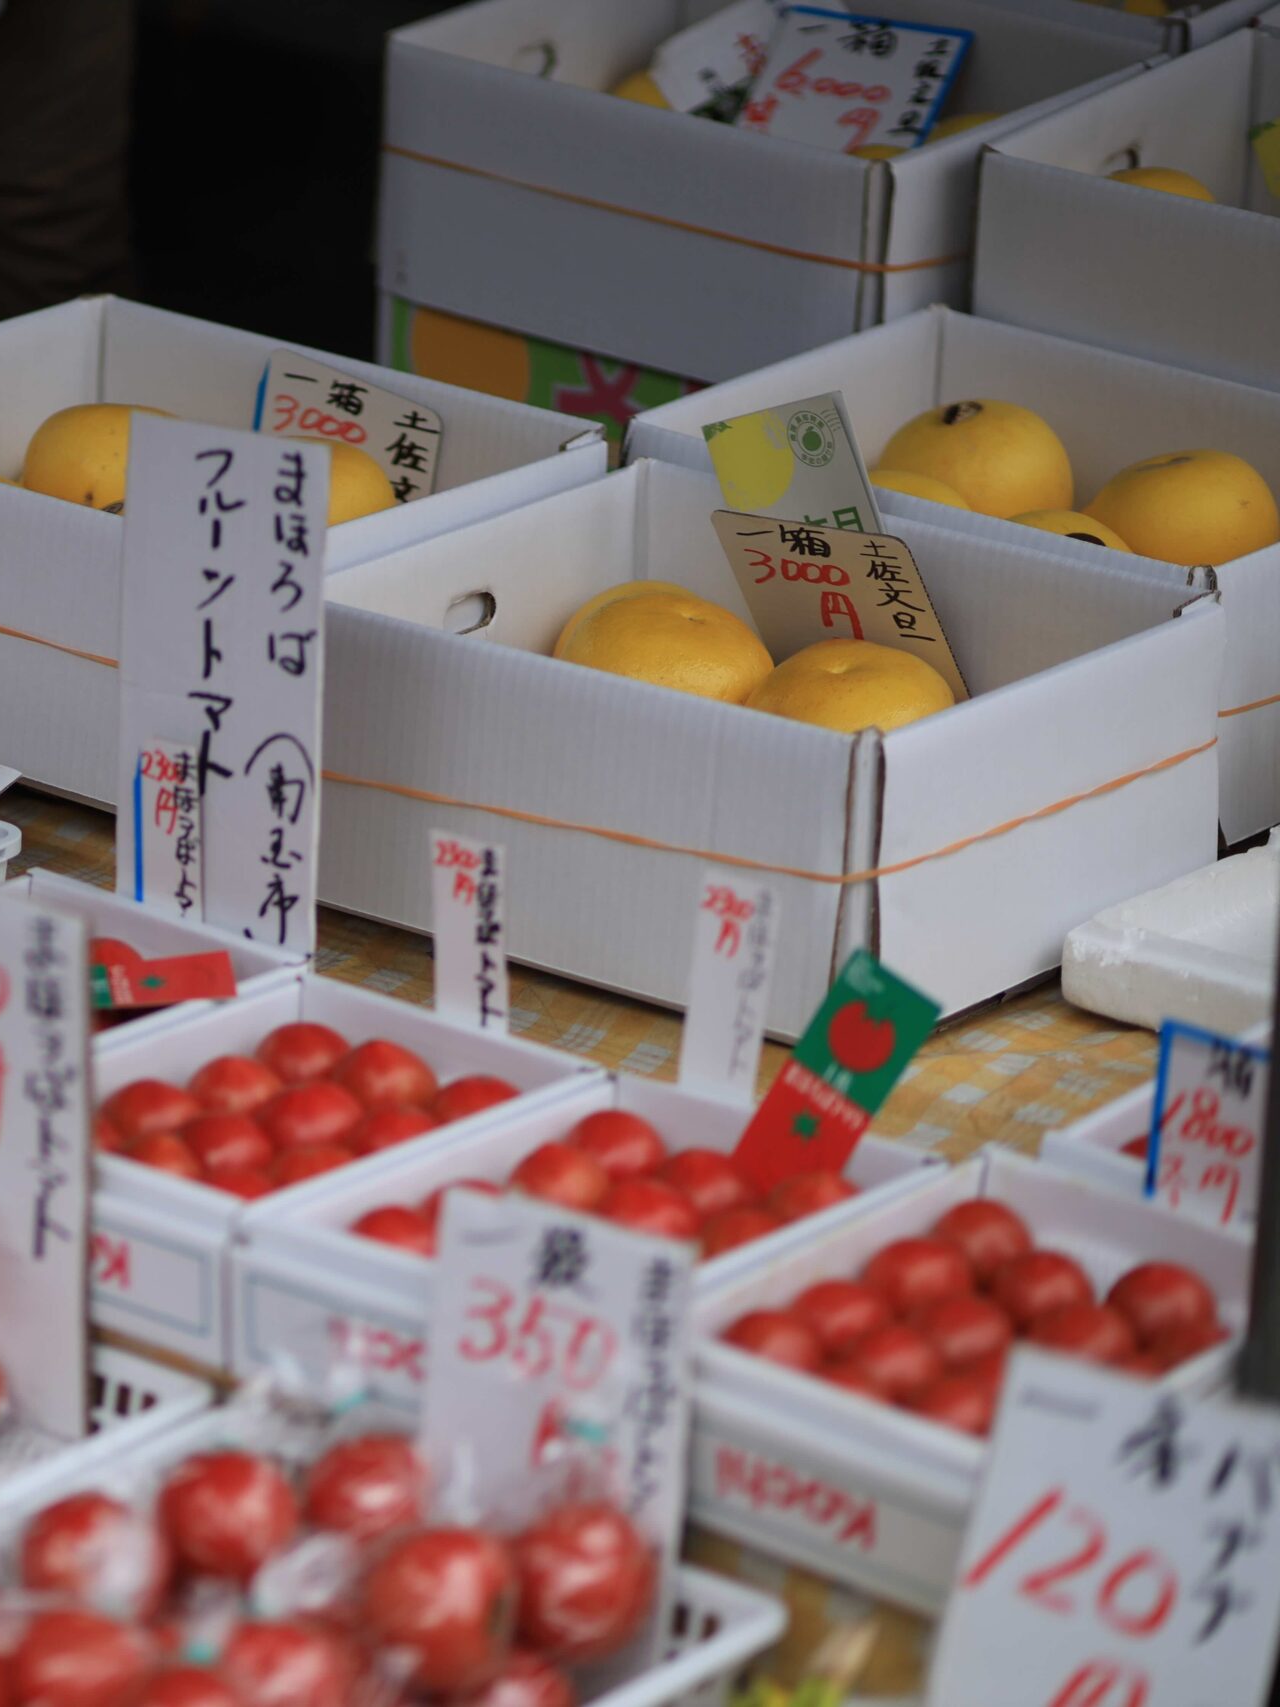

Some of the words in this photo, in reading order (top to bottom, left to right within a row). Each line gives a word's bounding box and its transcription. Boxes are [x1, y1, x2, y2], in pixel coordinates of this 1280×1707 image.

[273, 395, 367, 444] 3000
[744, 549, 851, 587] 3000
[458, 1276, 618, 1390] 350
[964, 1487, 1178, 1640] 120
